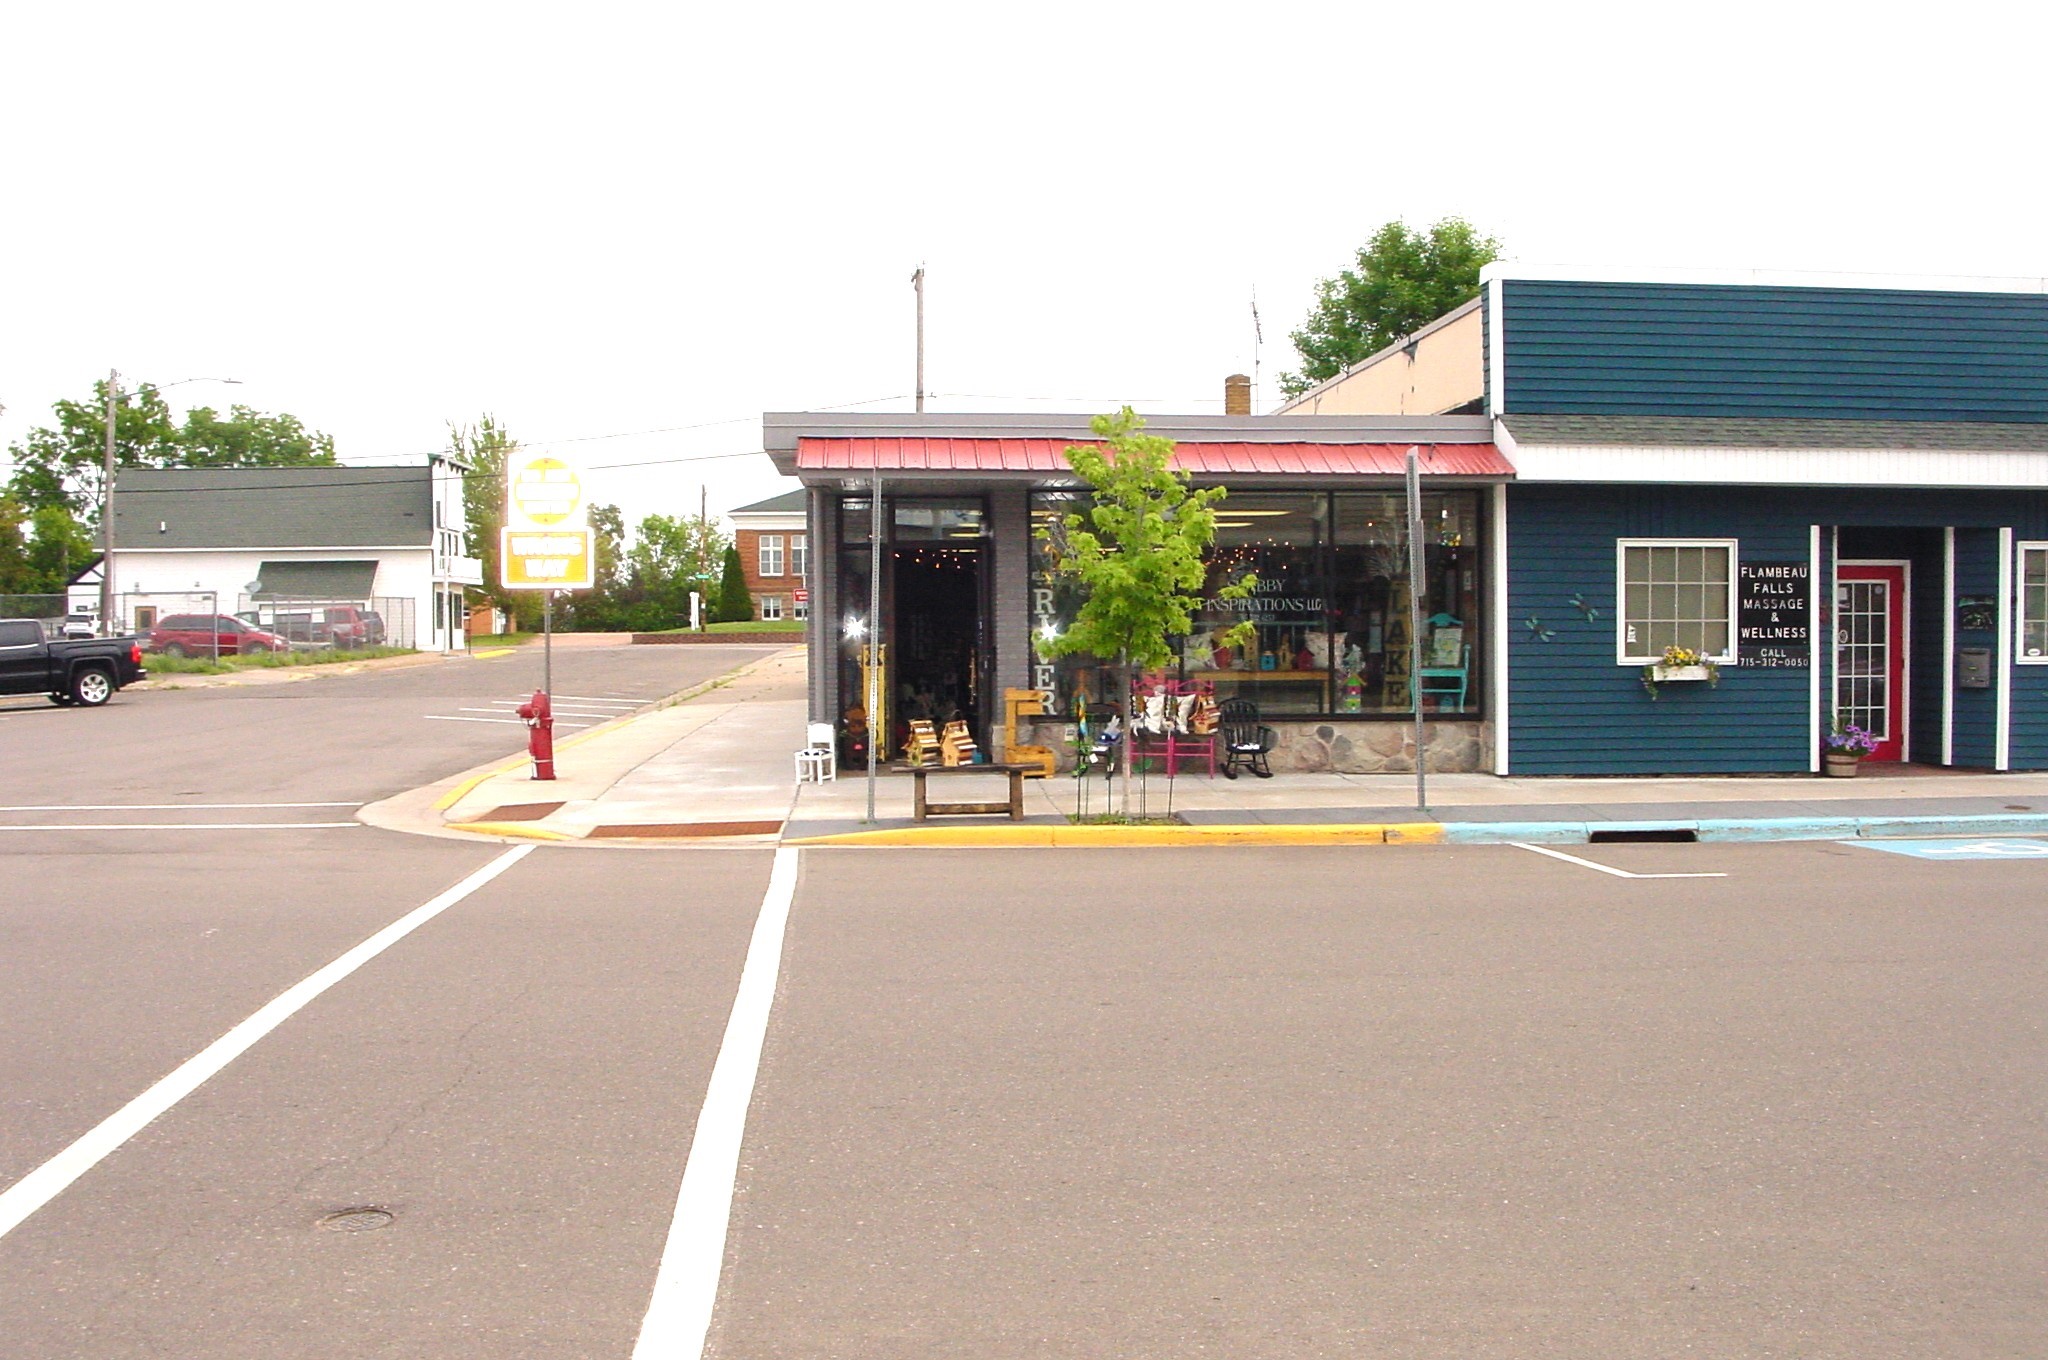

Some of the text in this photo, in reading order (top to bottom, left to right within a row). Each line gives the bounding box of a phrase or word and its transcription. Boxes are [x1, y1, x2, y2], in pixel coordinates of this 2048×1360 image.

[524, 558, 569, 577] WAY
[1741, 567, 1807, 578] FLAMBEAU
[1753, 582, 1794, 594] FALLS
[1207, 598, 1304, 611] INSPIRATIONS
[1743, 598, 1804, 609] MASSAGE
[1770, 612, 1780, 622] &
[1741, 627, 1806, 638] WELLNESS
[1760, 648, 1787, 657] CALL
[1740, 657, 1809, 667] 715-312-0050
